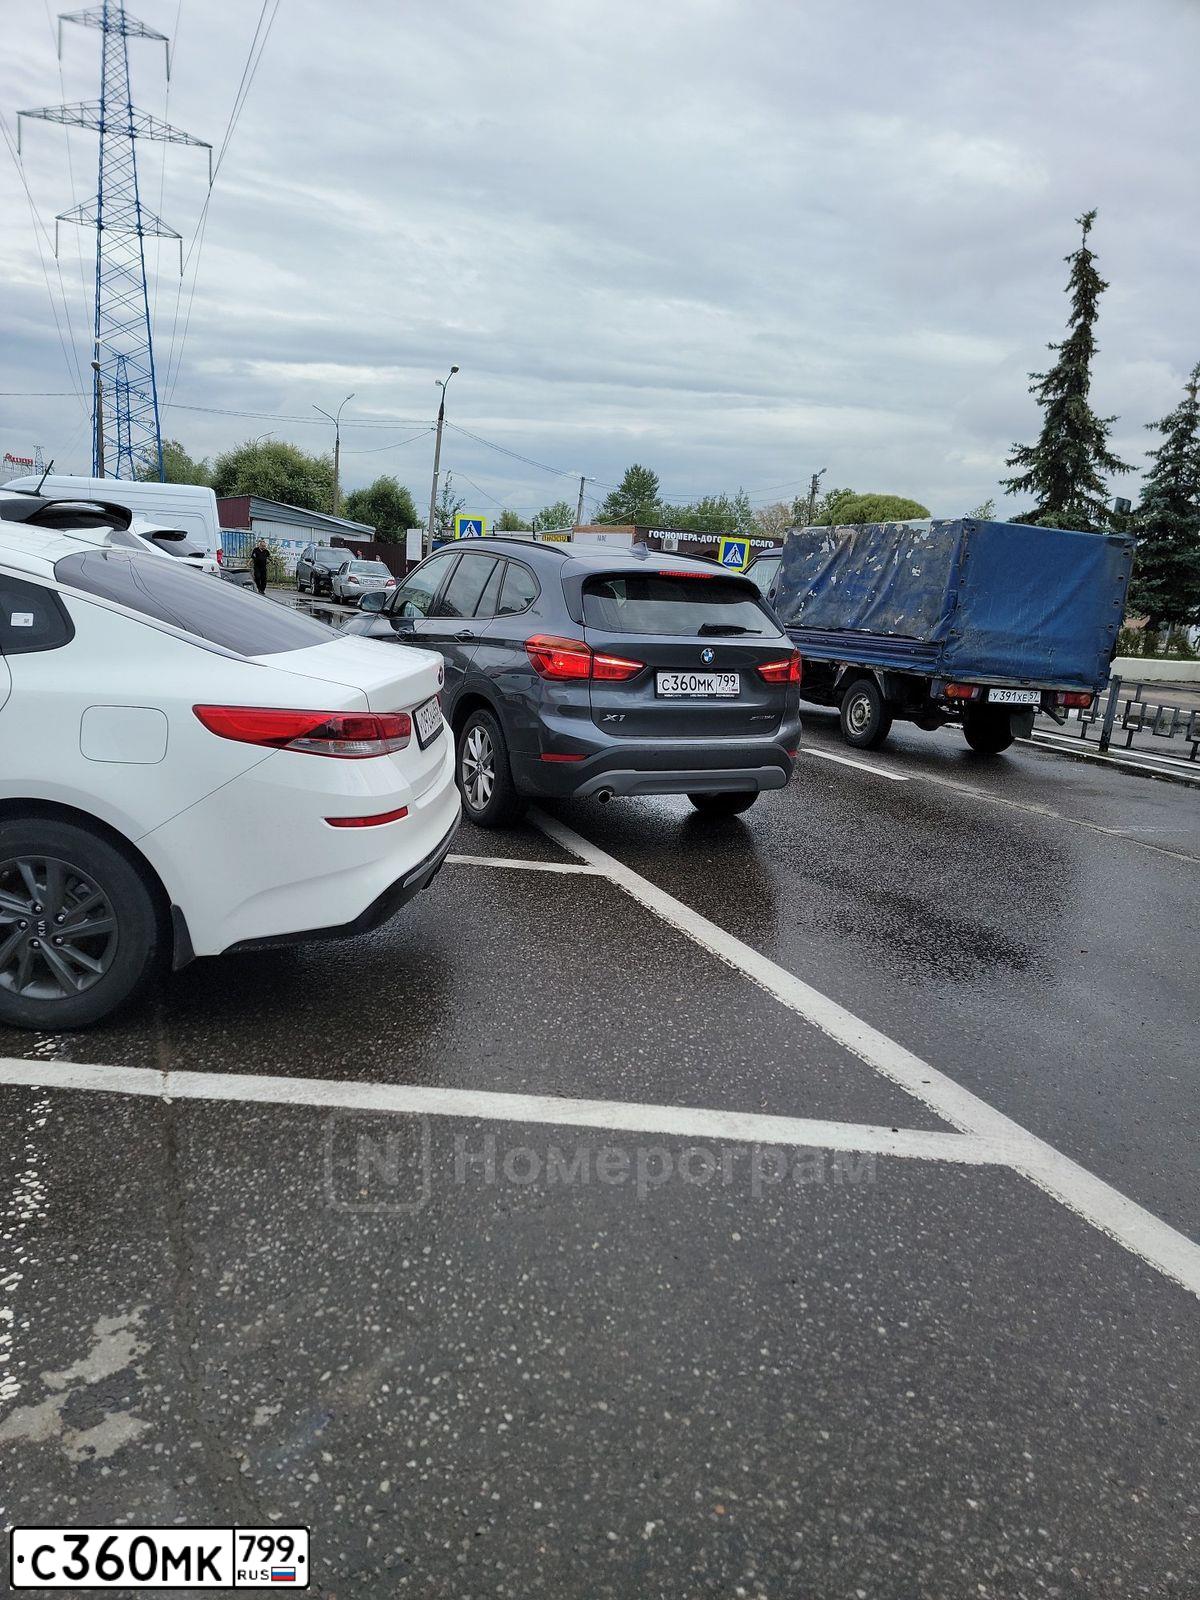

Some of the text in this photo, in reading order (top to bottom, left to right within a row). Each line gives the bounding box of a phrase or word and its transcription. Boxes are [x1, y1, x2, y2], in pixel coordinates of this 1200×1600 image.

[750, 539, 775, 548] ОСАГО
[661, 674, 737, 692] С360МК 799
[602, 714, 627, 722] X1
